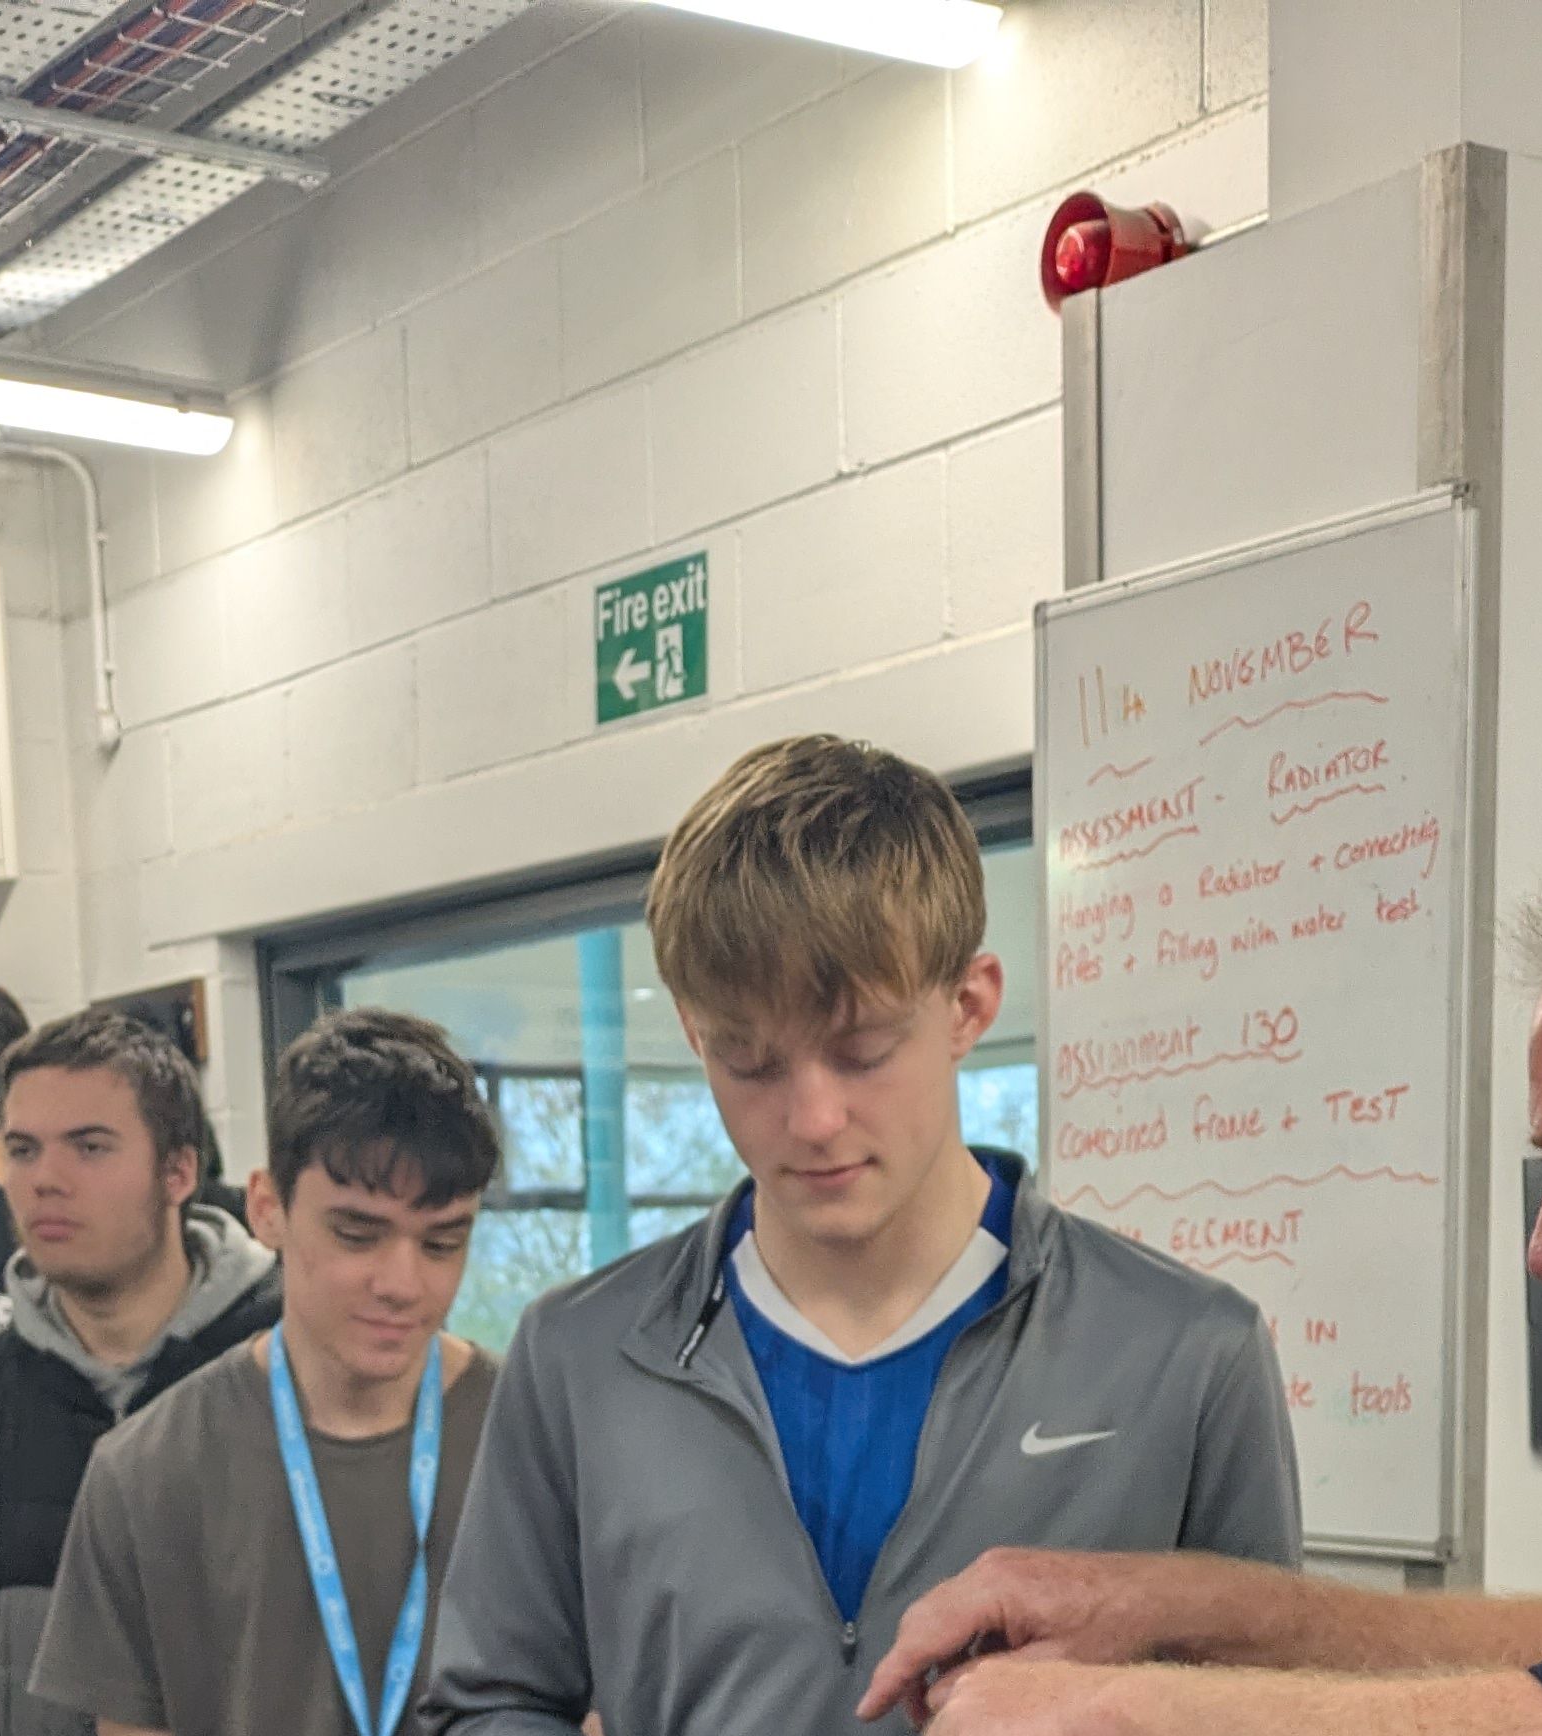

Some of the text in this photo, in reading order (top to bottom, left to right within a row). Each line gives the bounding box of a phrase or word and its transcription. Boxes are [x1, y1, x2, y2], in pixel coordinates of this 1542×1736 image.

[597, 563, 707, 641] Fire exit
[1187, 600, 1380, 706] NOVEMBER
[1266, 738, 1390, 799] RADIATOR
[1241, 1005, 1299, 1052] 130
[1169, 1208, 1304, 1252] ELEMENT
[1304, 1318, 1339, 1344] IN
[1349, 1370, 1413, 1418] tools
